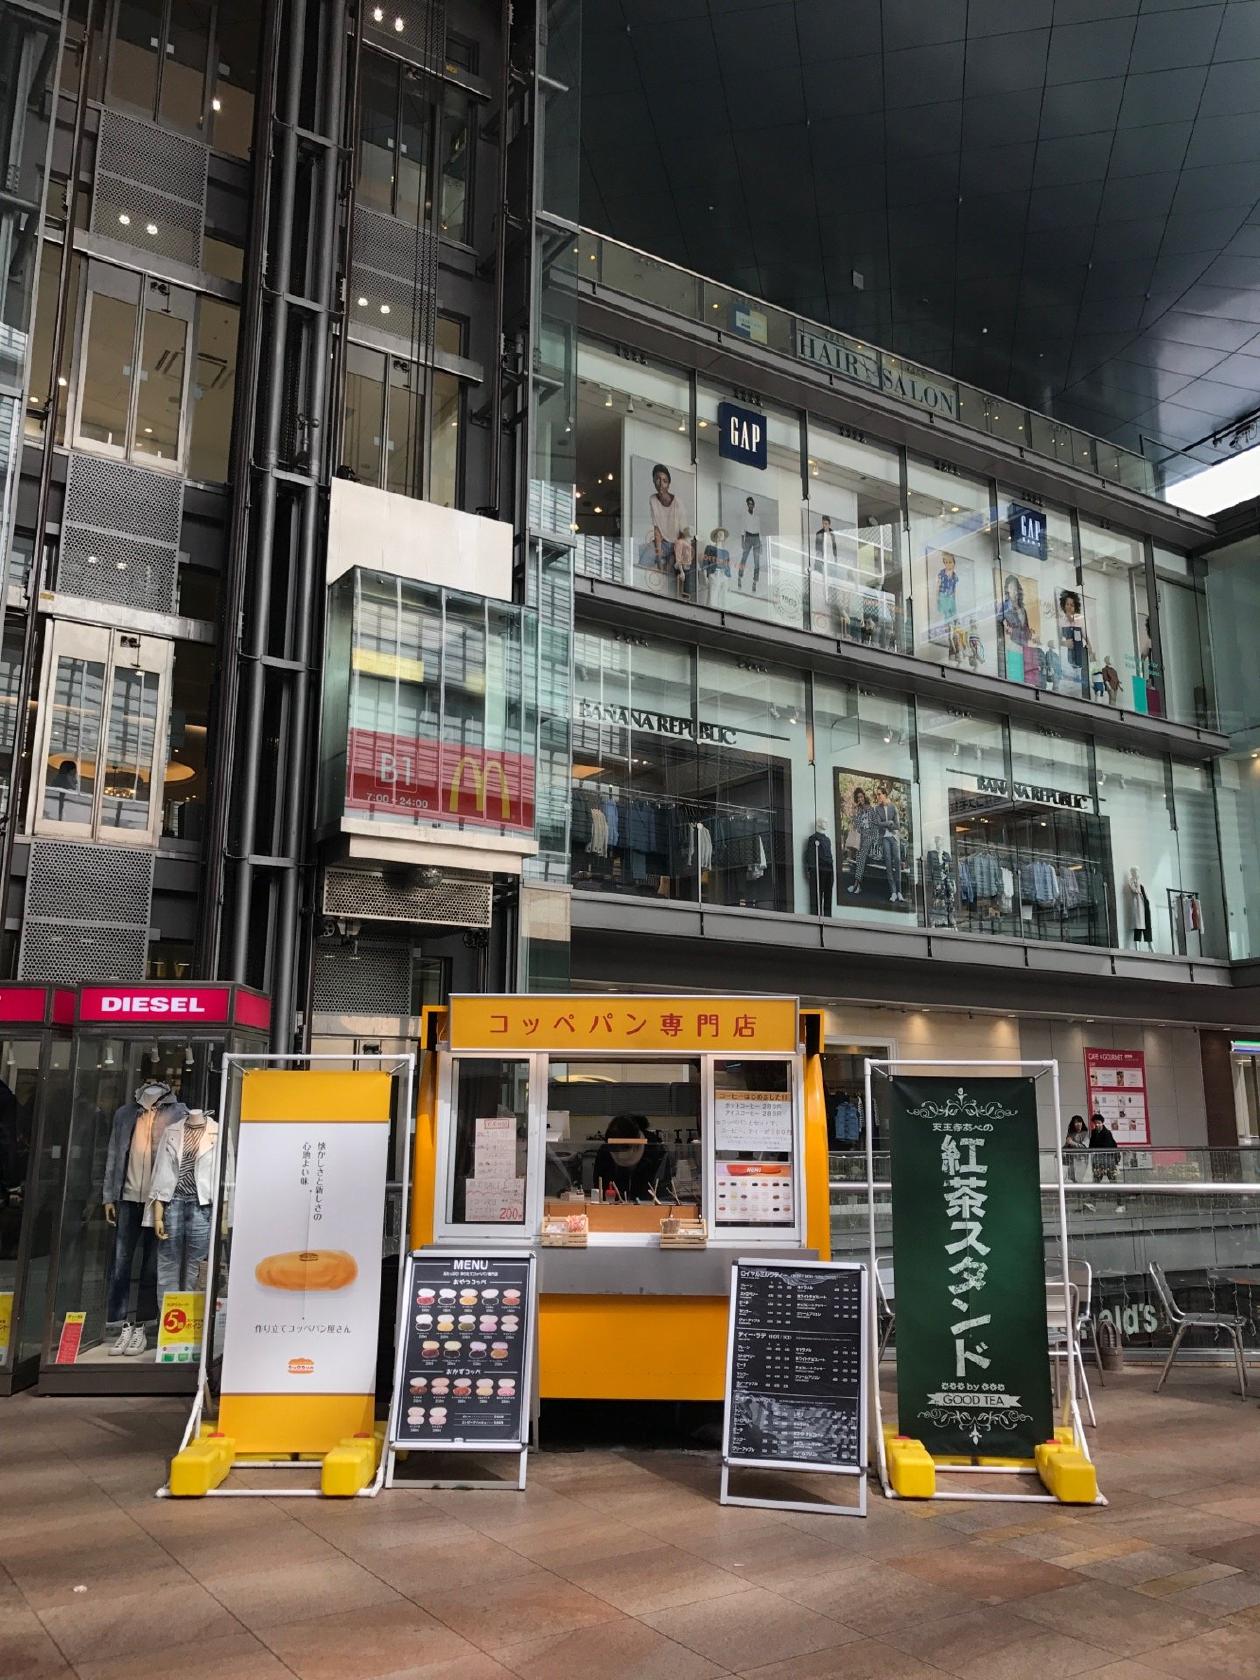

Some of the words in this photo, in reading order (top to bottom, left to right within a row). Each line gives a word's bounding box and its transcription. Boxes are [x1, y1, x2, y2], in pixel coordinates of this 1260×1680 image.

[798, 333, 862, 377] HAIR
[883, 368, 954, 415] SALON
[728, 415, 762, 452] GAP
[1020, 515, 1041, 541] GAP
[578, 700, 655, 731] BANANA
[656, 715, 737, 745] REPUBLIC
[380, 752, 411, 786] B1
[366, 793, 390, 804] 7:00
[399, 796, 429, 809] 24:00
[101, 996, 205, 1013] DIESEL
[489, 1012, 759, 1039] コッペパン専門店
[300, 1141, 312, 1186] 心地よい味
[453, 1259, 489, 1270] MENU
[940, 1134, 992, 1377] 紅茶スタンド
[254, 1323, 352, 1334] 作り立てコッペパン屋さん
[445, 1368, 482, 1376] おかずコッペ
[942, 1394, 981, 1405] GOOD
[983, 1395, 1005, 1406] TEA
[966, 1382, 980, 1392] by
